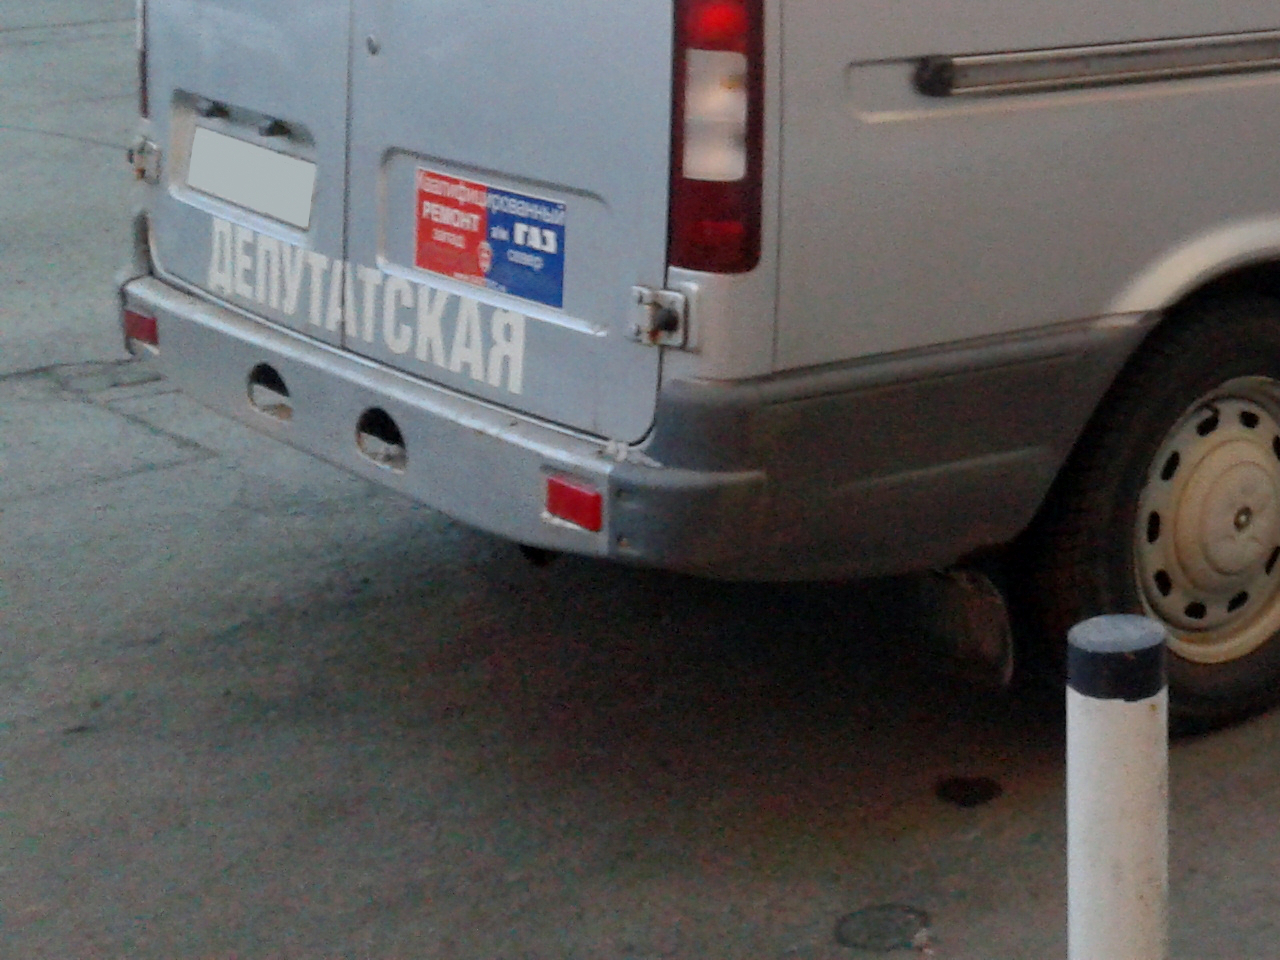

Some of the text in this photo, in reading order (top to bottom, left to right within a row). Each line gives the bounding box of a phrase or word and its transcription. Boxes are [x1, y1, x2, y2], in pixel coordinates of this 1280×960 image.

[422, 200, 481, 232] РЕМОНТ
[513, 221, 558, 254] ГАЗ
[208, 217, 526, 394] ДЕПУТАТСКАЯ
